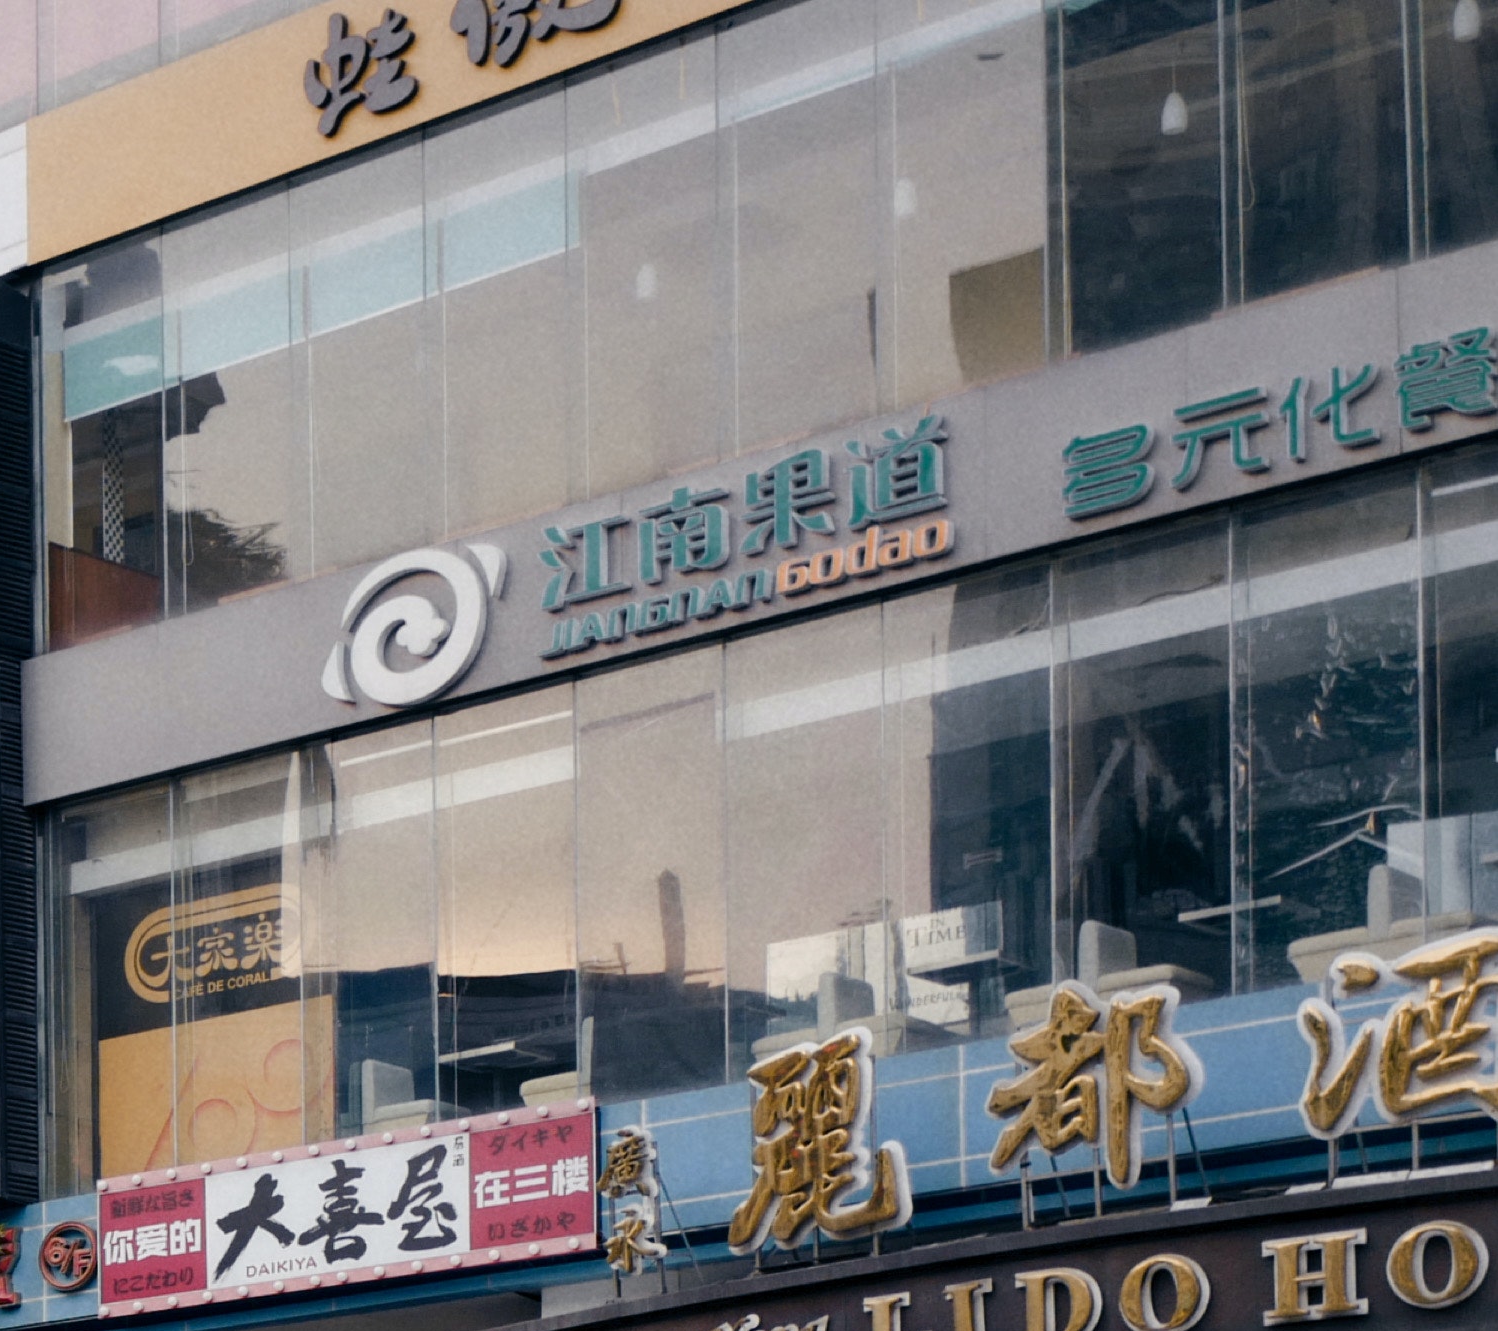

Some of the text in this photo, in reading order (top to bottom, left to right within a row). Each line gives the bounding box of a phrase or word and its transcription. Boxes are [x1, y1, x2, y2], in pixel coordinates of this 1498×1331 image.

[1061, 327, 1497, 519] 多元化餐
[538, 414, 949, 612] 江南果道
[207, 977, 225, 994] DE
[226, 971, 270, 991] CORAL
[473, 1154, 590, 1209] 在三楼
[214, 1144, 458, 1284] 大喜屋
[103, 1218, 204, 1266] 你爱的
[245, 1255, 318, 1279] DAIKIYA
